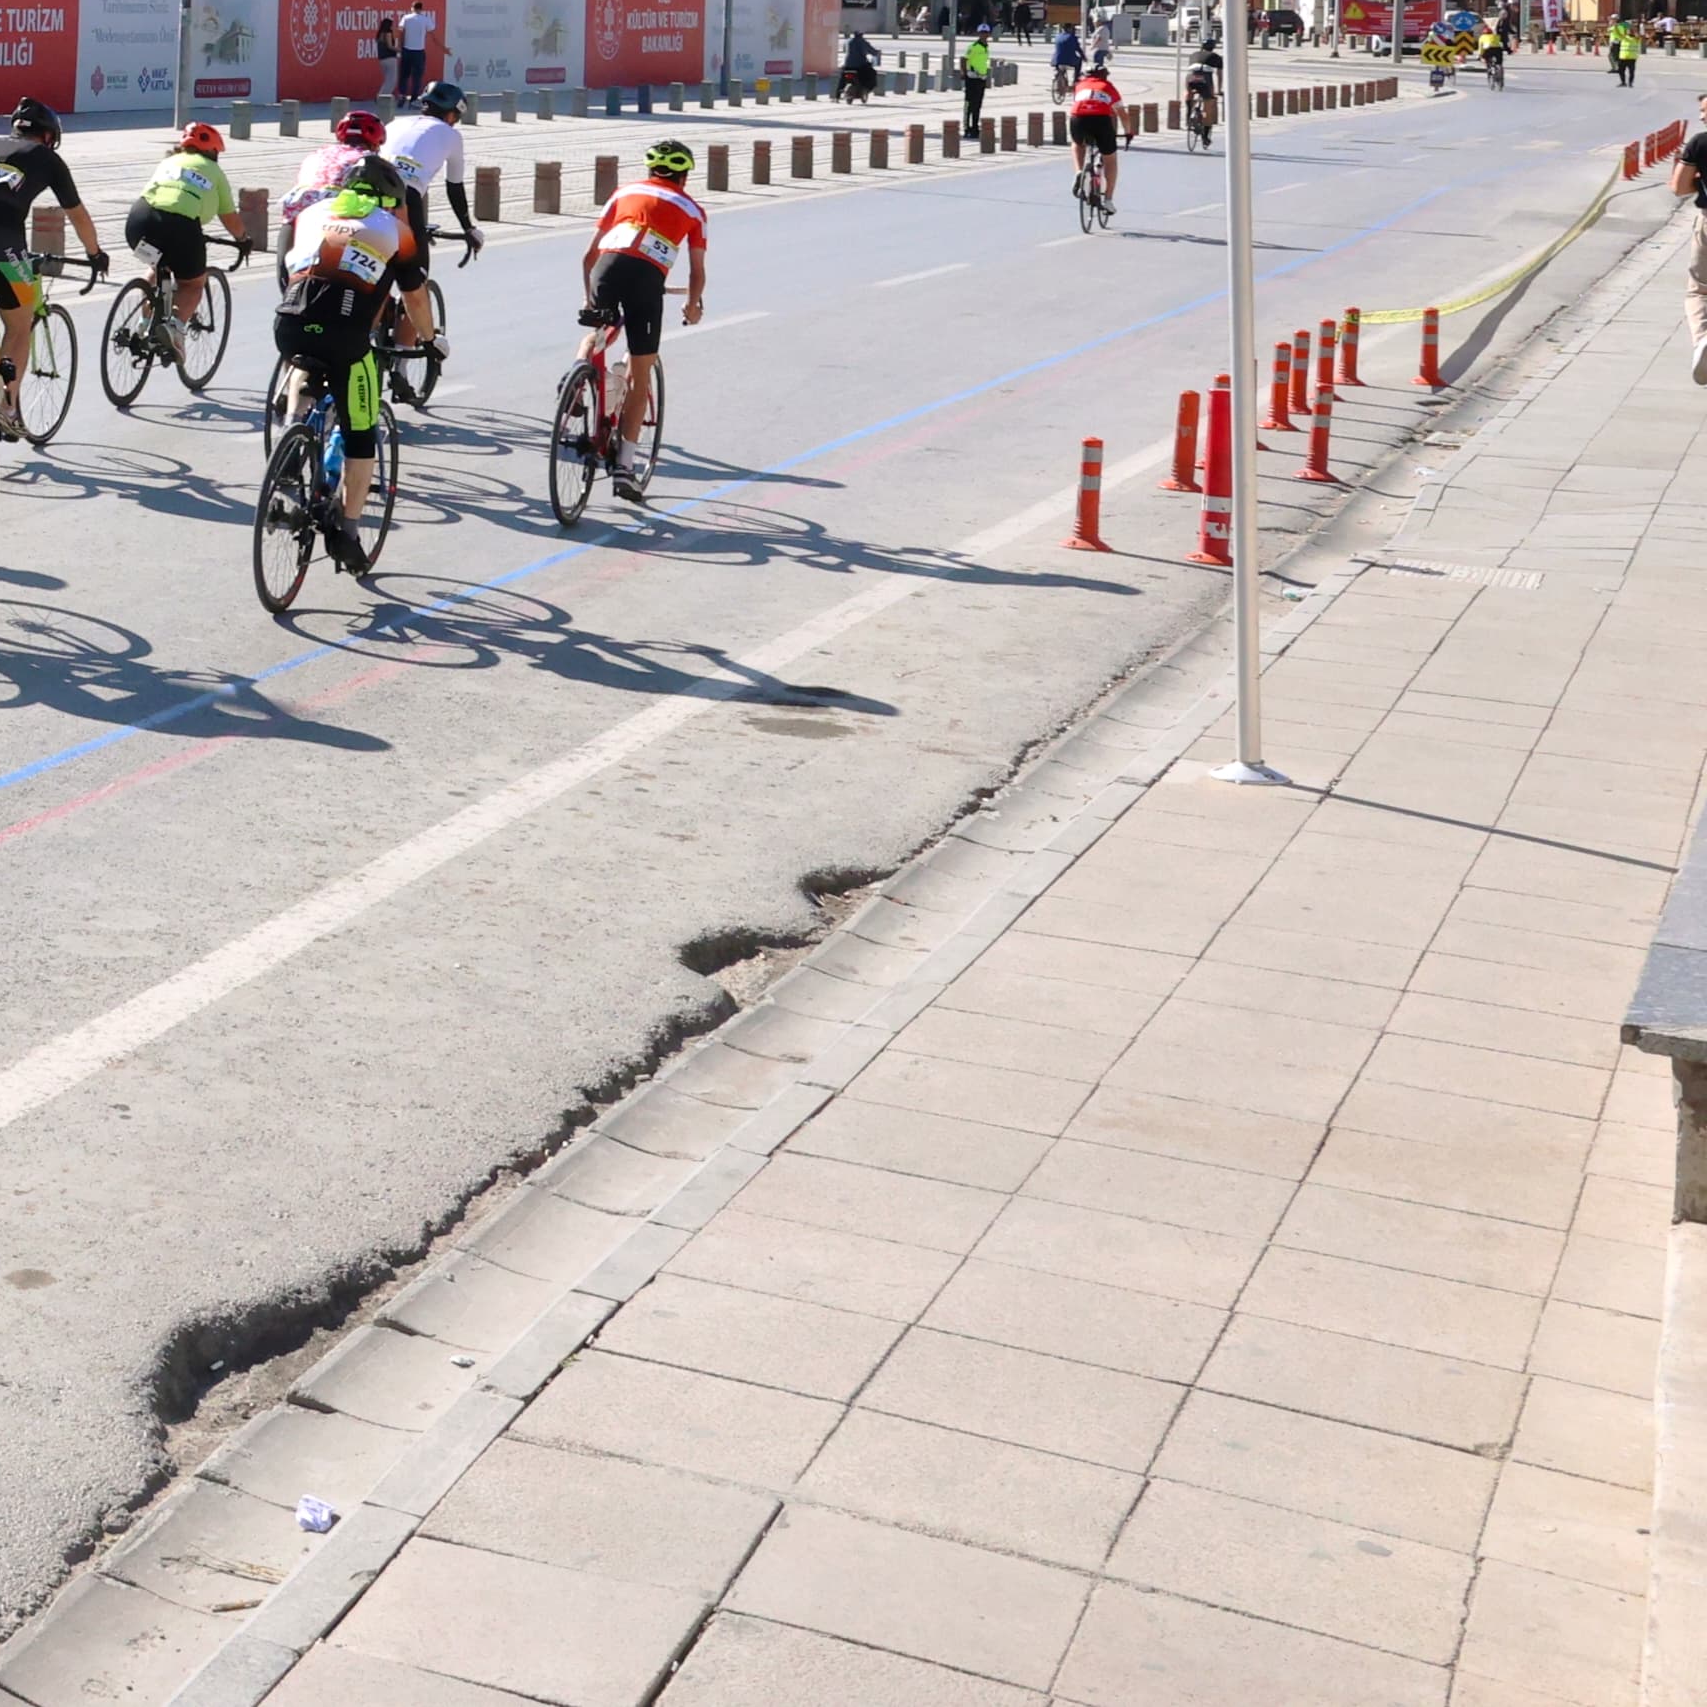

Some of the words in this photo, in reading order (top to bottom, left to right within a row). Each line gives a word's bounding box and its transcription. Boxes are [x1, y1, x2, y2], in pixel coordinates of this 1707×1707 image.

[6, 3, 64, 32] TURİZM
[335, 5, 378, 31] KÜLTÜR
[659, 11, 669, 29] VE
[653, 240, 669, 254] 53
[350, 249, 377, 272] 724
